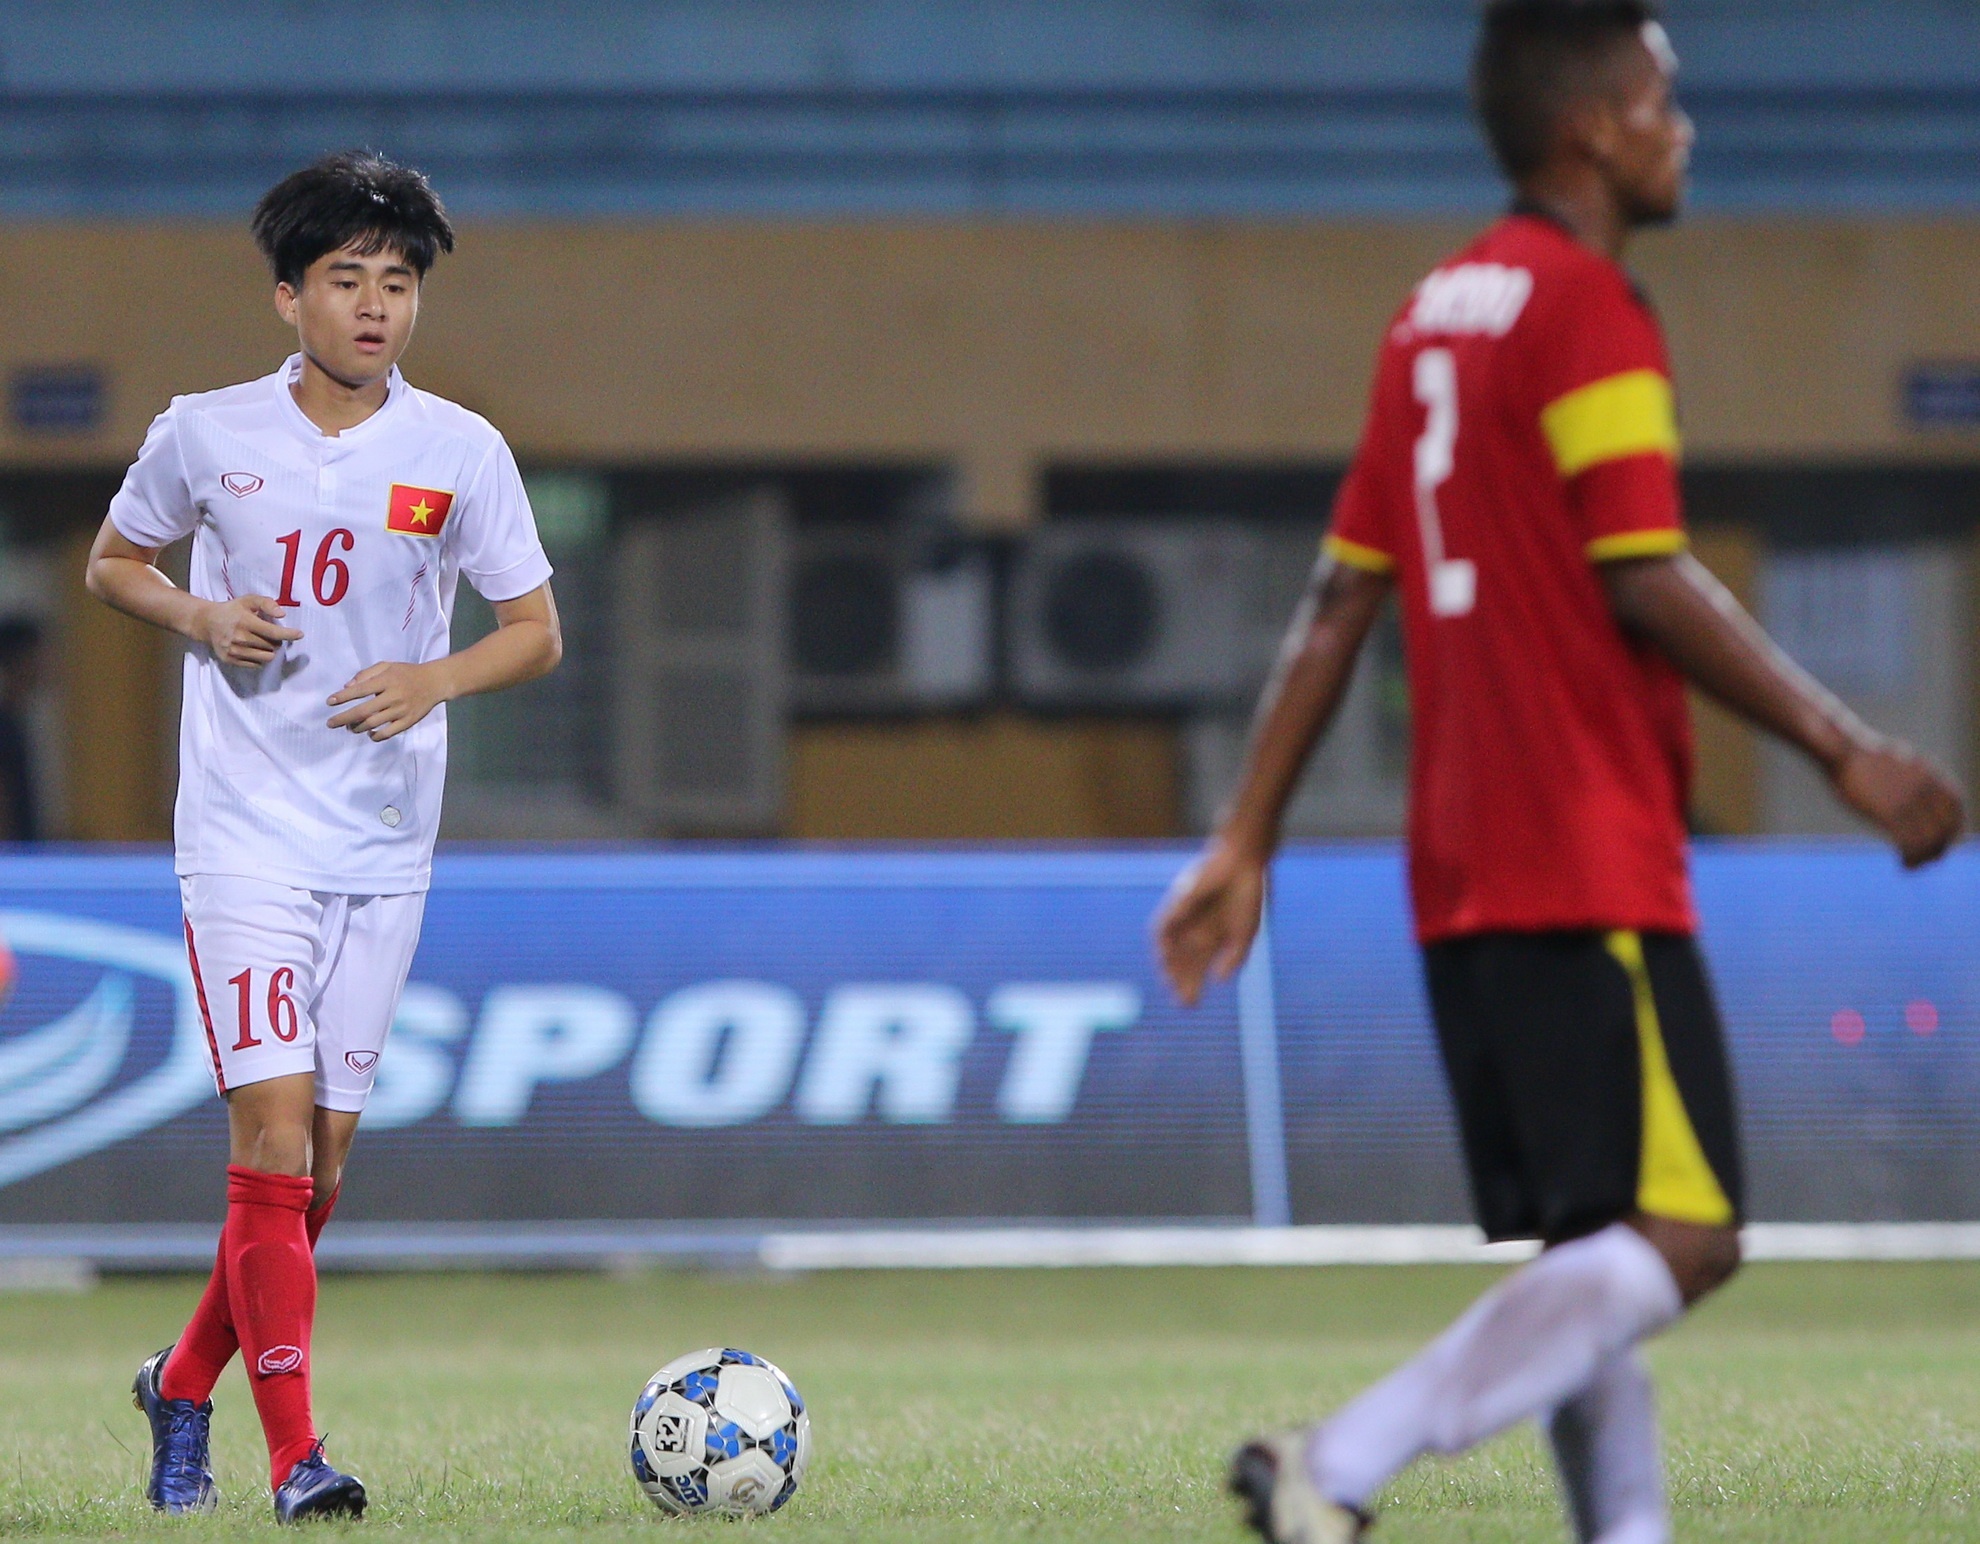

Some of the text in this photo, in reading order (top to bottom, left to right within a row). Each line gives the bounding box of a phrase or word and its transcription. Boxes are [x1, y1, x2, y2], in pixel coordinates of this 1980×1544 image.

[274, 528, 355, 608] 16
[228, 967, 298, 1051] 16
[352, 980, 1142, 1129] SPORT
